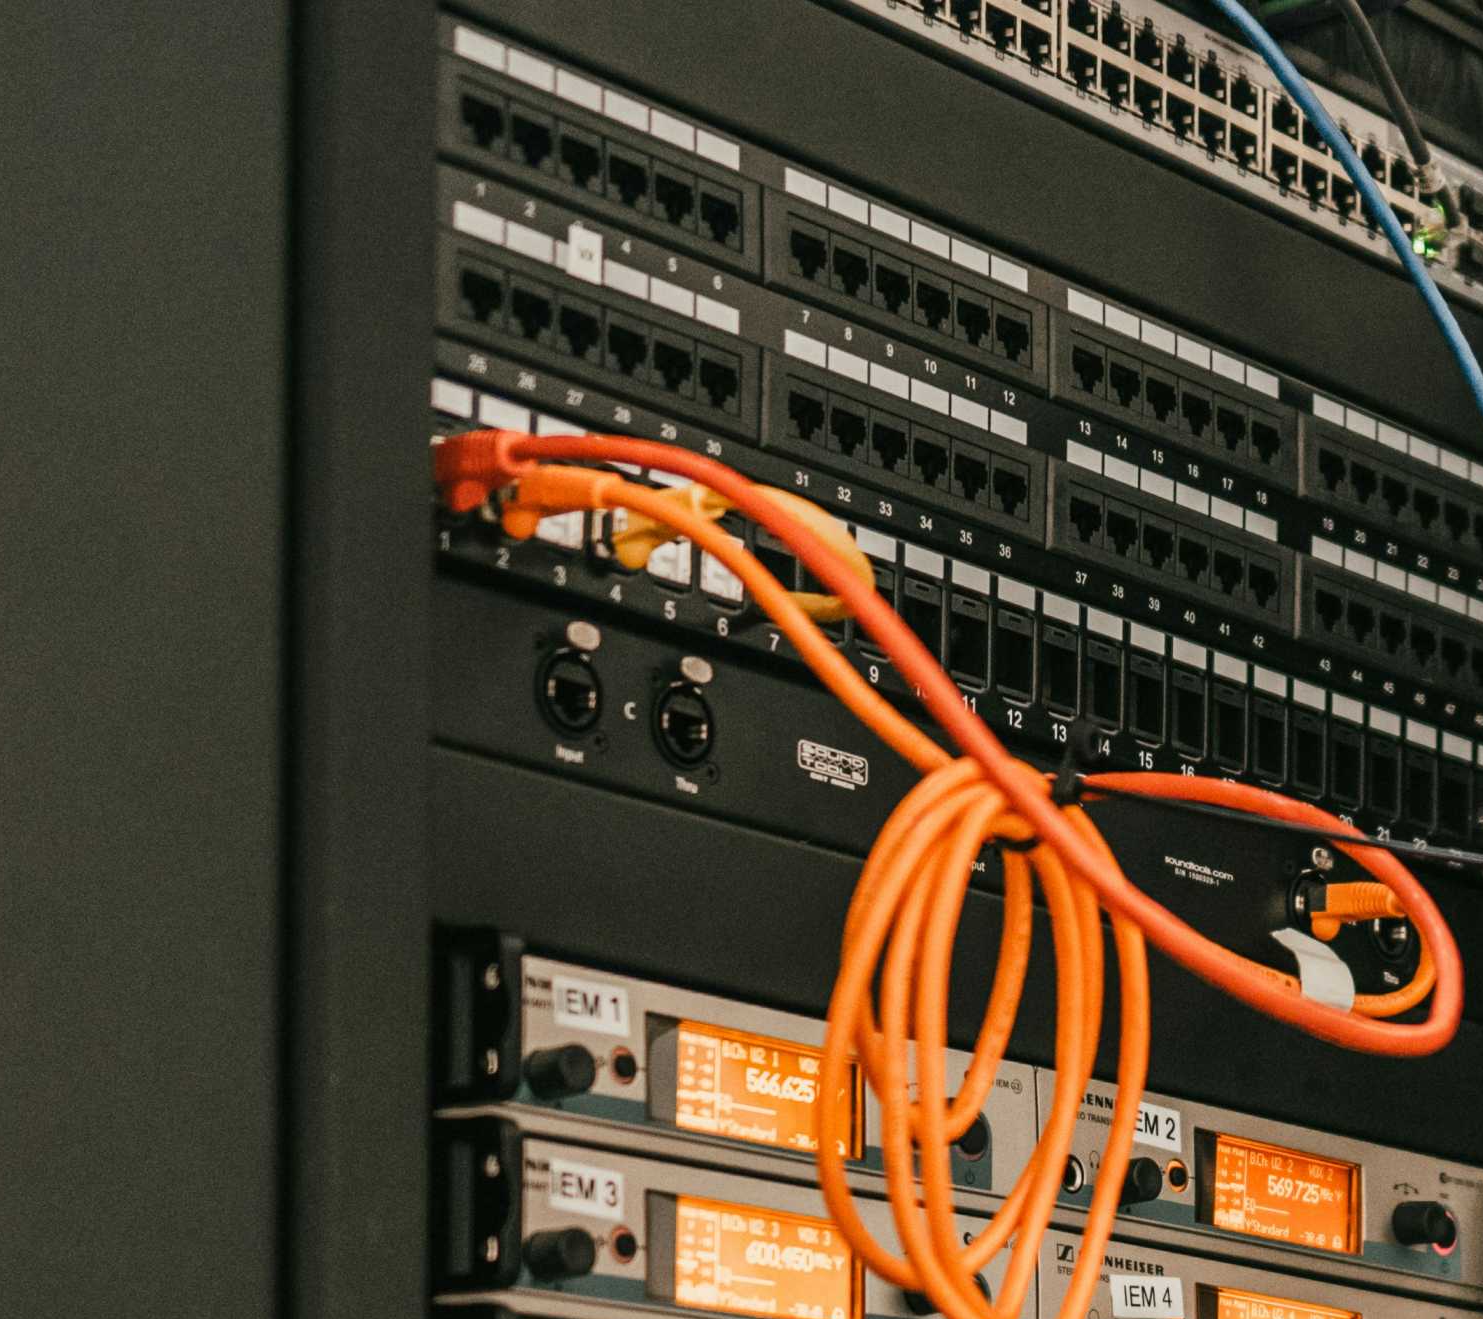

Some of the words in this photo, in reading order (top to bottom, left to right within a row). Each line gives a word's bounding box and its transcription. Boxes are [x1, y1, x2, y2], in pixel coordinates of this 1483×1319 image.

[524, 200, 536, 218] 2
[621, 239, 632, 254] 4
[667, 256, 678, 273] 5
[712, 275, 723, 291] 6
[802, 309, 811, 324] 7
[844, 326, 853, 341] 8
[885, 342, 895, 358] 9
[923, 358, 938, 375] 10
[965, 374, 977, 390] 11
[1003, 389, 1016, 406] 12
[1079, 420, 1092, 436] 13
[1116, 434, 1128, 450] 14
[1152, 449, 1164, 465] 15
[1187, 463, 1200, 479] 16
[1222, 477, 1234, 491] 17
[1256, 490, 1268, 506] 18
[1386, 542, 1398, 556] 21
[1416, 554, 1429, 569] 22
[706, 439, 722, 456] 30
[795, 470, 809, 487] 31
[837, 485, 852, 503] 32
[878, 500, 893, 517] 33
[919, 515, 933, 531] 34
[959, 529, 973, 546] 35
[998, 543, 1012, 559] 36
[1075, 570, 1088, 585] 37
[1112, 583, 1125, 599] 38
[1148, 596, 1161, 612] 39
[1183, 610, 1196, 625] 40
[1218, 622, 1231, 636] 41
[1252, 634, 1265, 649] 42
[1319, 658, 1332, 672] 43
[1351, 670, 1363, 682] 44
[496, 547, 510, 569] 2
[553, 565, 567, 586] 3
[609, 584, 622, 602] 4
[664, 600, 676, 620] 5
[717, 616, 729, 637] 6
[769, 633, 780, 652] 7
[869, 665, 880, 684] 9
[1006, 708, 1023, 729] 12
[1051, 722, 1068, 743] 13
[1138, 750, 1154, 770] 15
[624, 702, 636, 720] C
[972, 861, 985, 872] put
[1165, 856, 1234, 881] soundtools.com
[611, 997, 620, 1022] 1
[1133, 1110, 1159, 1137] EM
[1166, 1117, 1176, 1141] 2
[605, 1180, 618, 1208] 3
[1268, 1175, 1320, 1205] 569.725
[1103, 1255, 1164, 1276] NHEISER
[1123, 1284, 1157, 1308] IEM
[1162, 1286, 1173, 1309] 4
